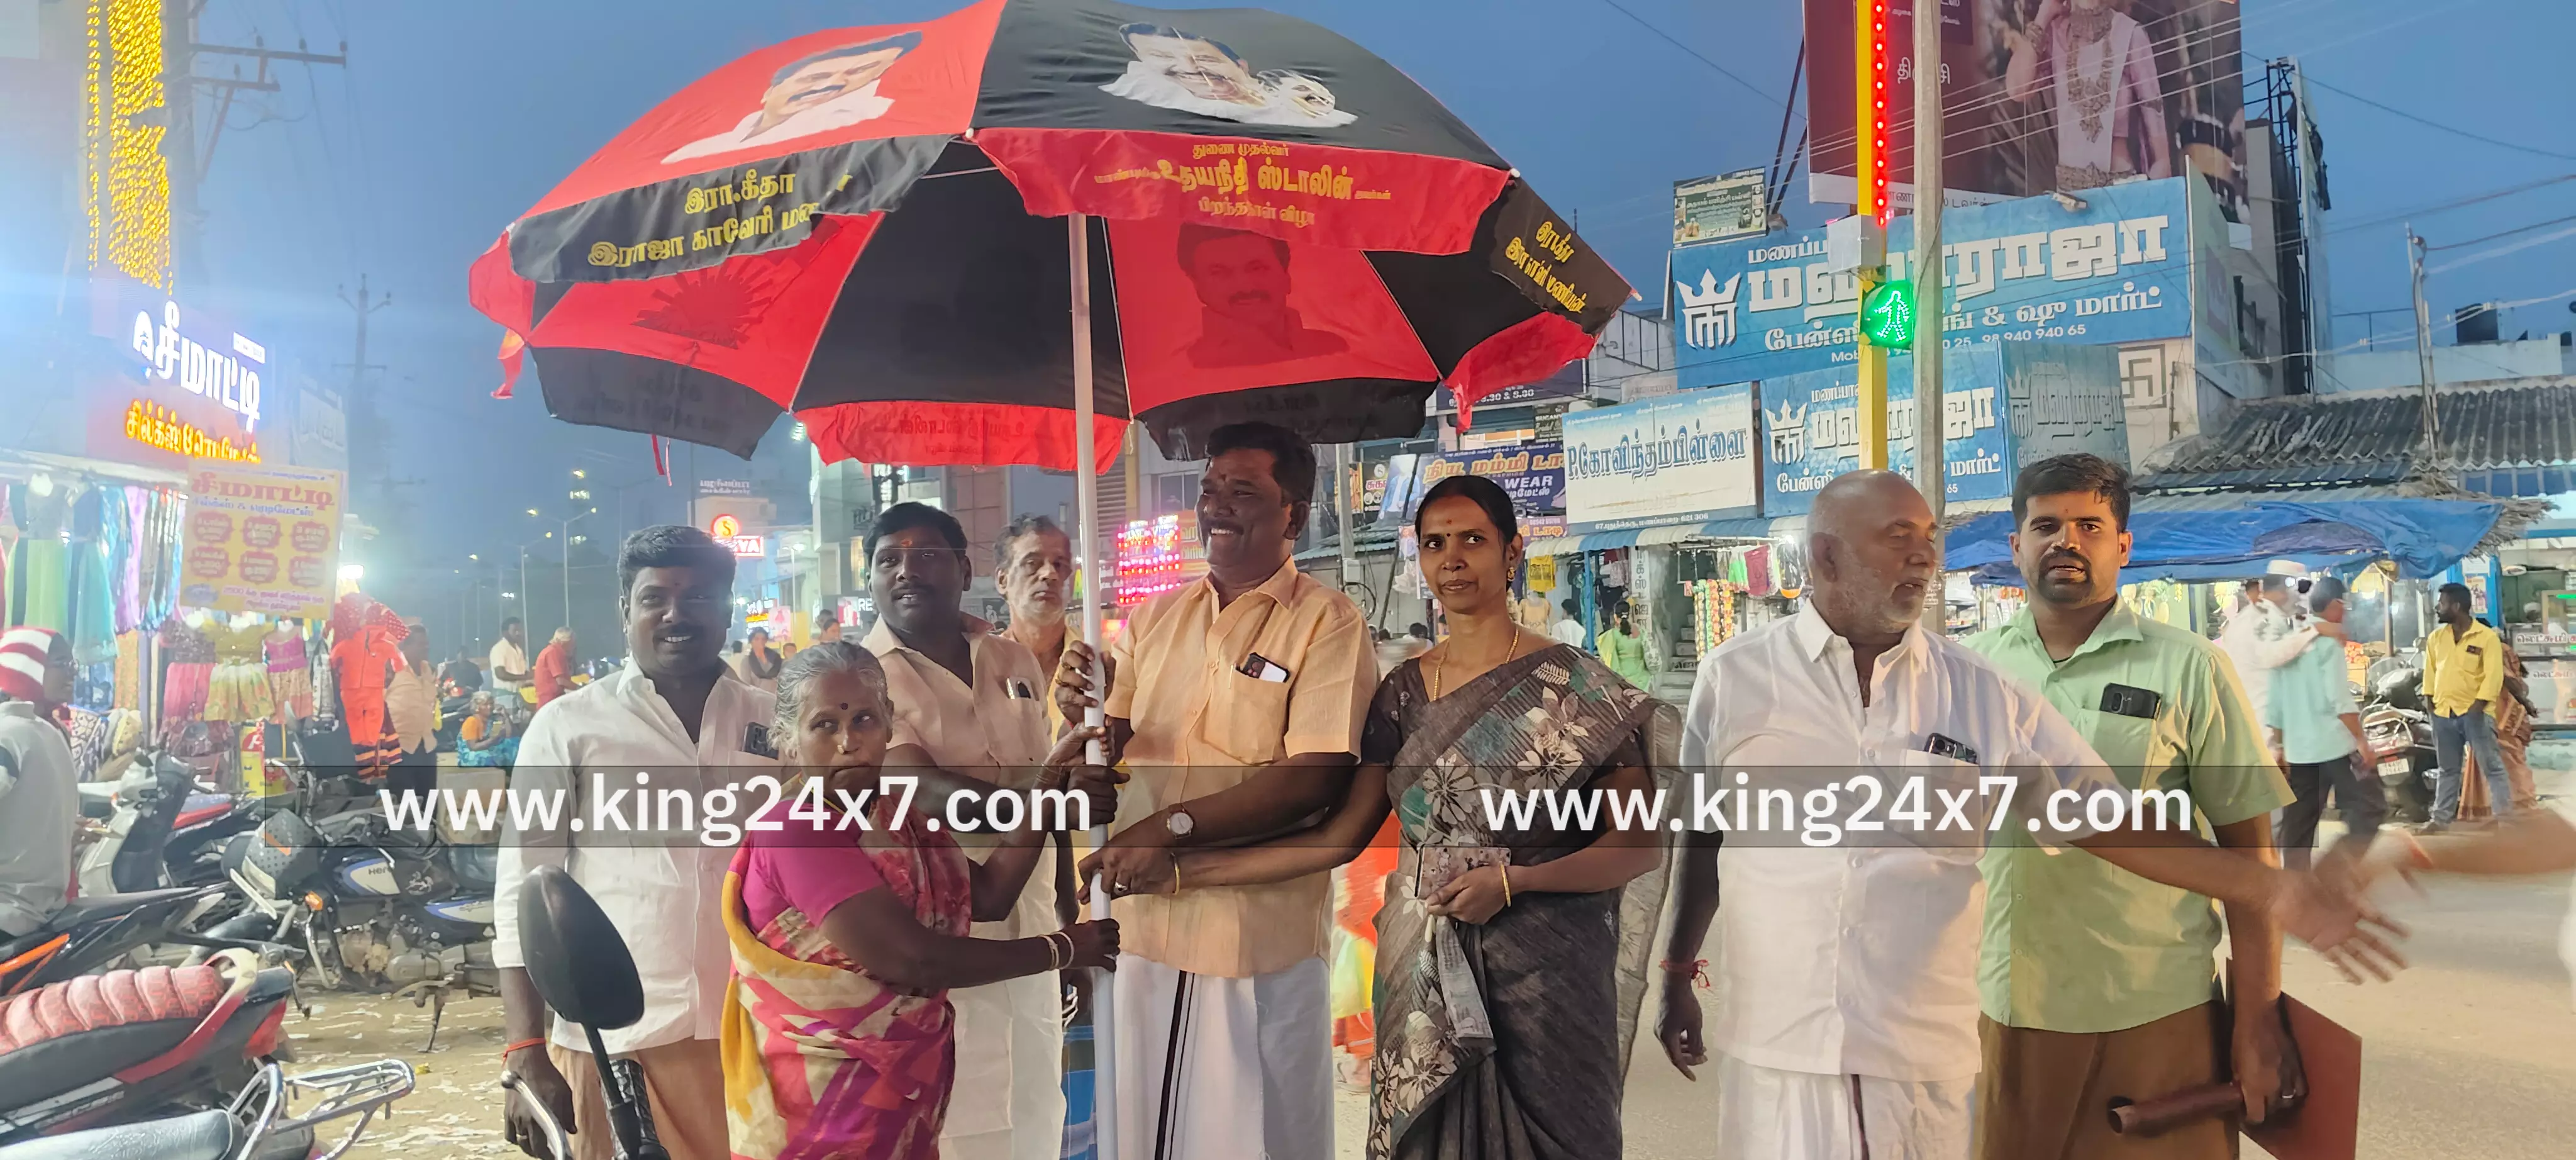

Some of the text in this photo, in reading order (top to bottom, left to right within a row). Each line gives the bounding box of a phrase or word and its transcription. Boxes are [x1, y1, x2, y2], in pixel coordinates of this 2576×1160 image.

[684, 169, 796, 215] இரா.கீதா
[1258, 157, 1353, 200] ஸ்டாலின்
[691, 204, 774, 252] காவேரி
[1982, 306, 2008, 326] &
[2075, 281, 2163, 317] மார்ட்
[2003, 329, 2032, 342] 940
[2035, 326, 2064, 340] 940
[2067, 323, 2087, 336] 65
[1950, 447, 2002, 477] மார்ட்
[1505, 475, 1553, 489] WEAR
[858, 598, 873, 611] RE
